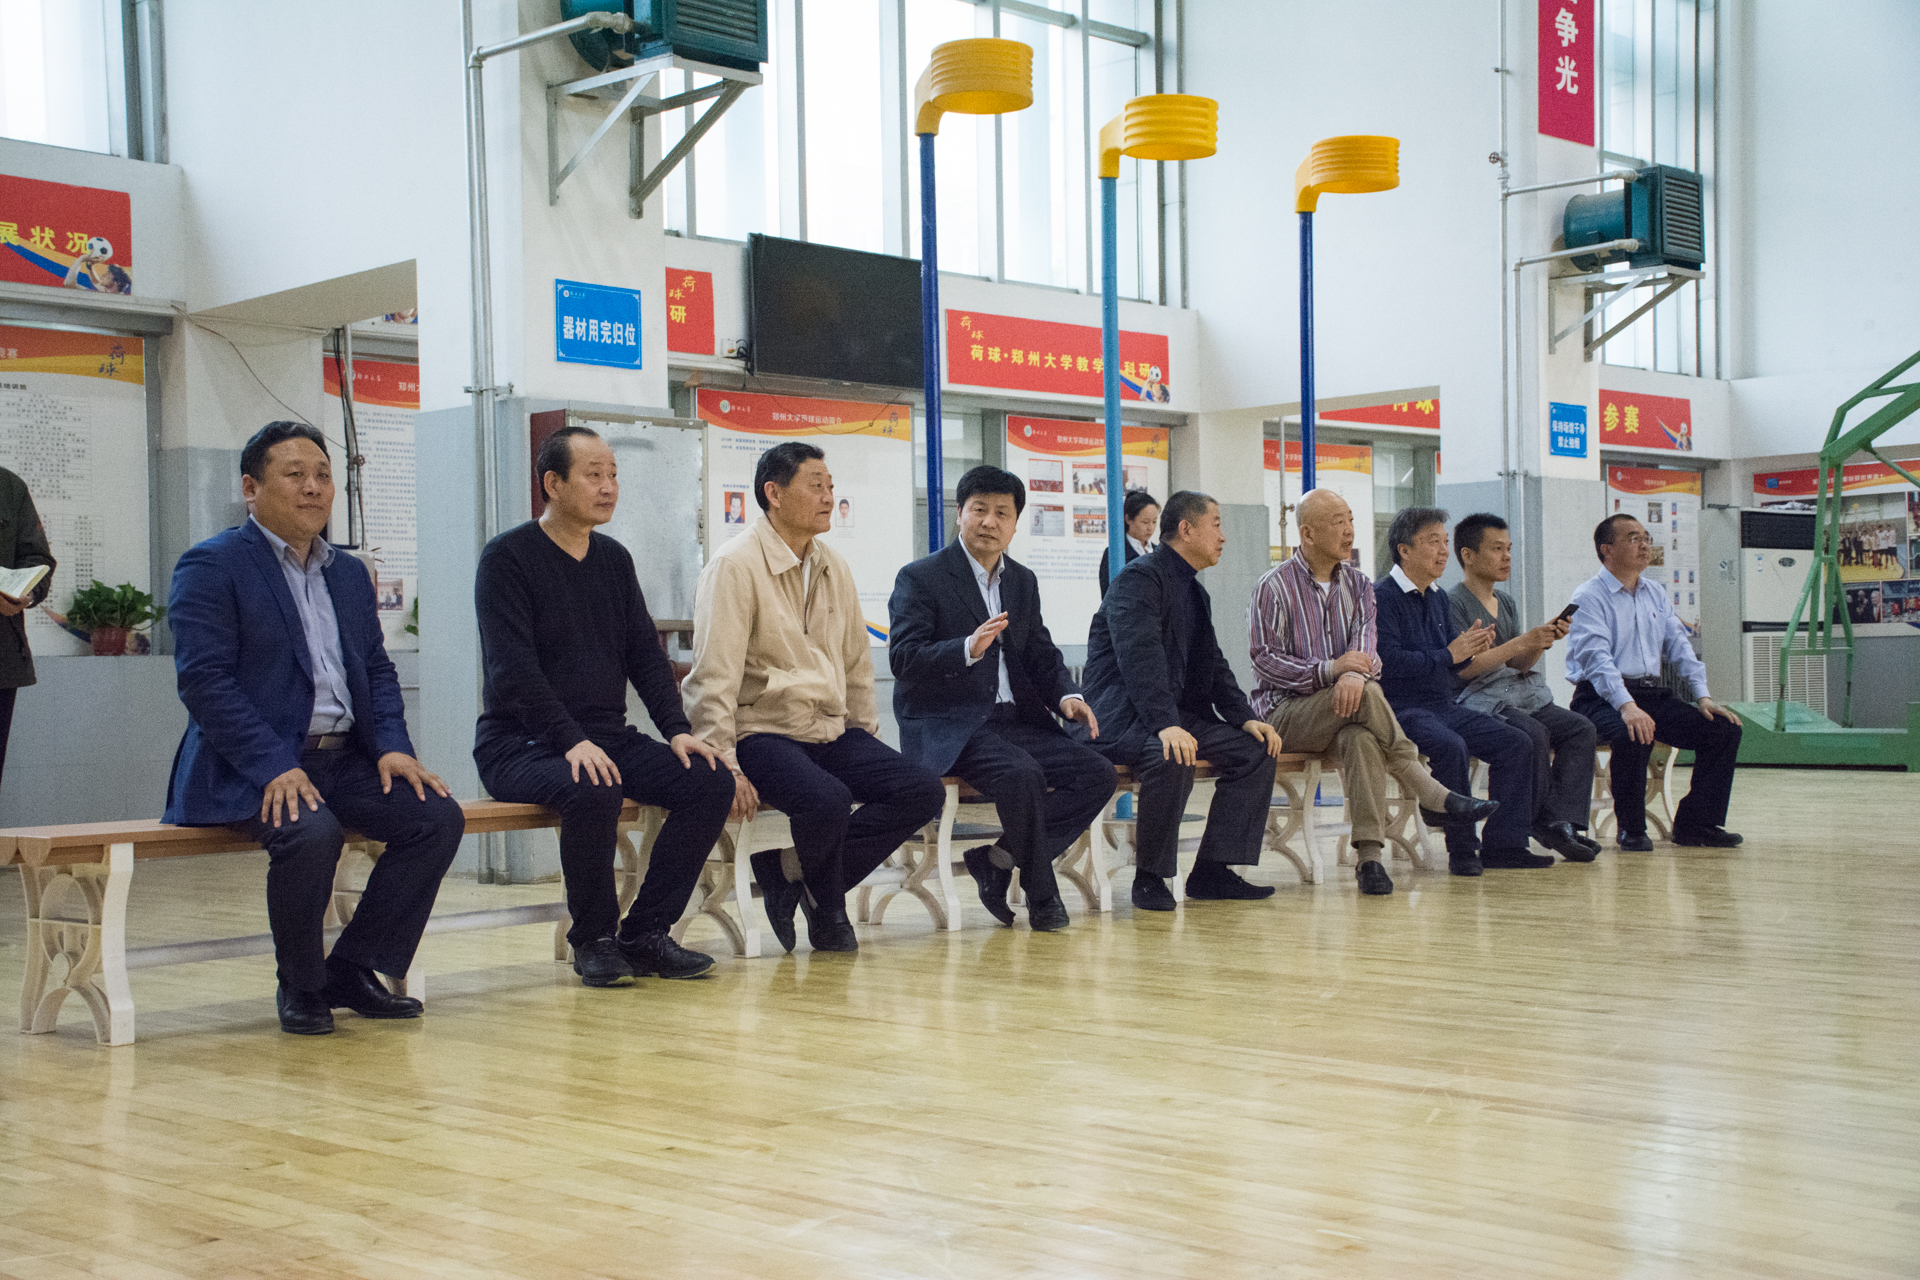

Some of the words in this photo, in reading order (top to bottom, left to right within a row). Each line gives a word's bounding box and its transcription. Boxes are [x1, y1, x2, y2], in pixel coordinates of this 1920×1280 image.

[1555, 0, 1579, 94] 争光
[0, 221, 91, 255] 展状况
[669, 275, 696, 300] 荷球
[562, 315, 637, 346] 器材用完归位
[670, 305, 687, 324] 研
[970, 344, 1151, 378] 荷球·郑州大学教学科研
[1603, 402, 1640, 434] 参赛
